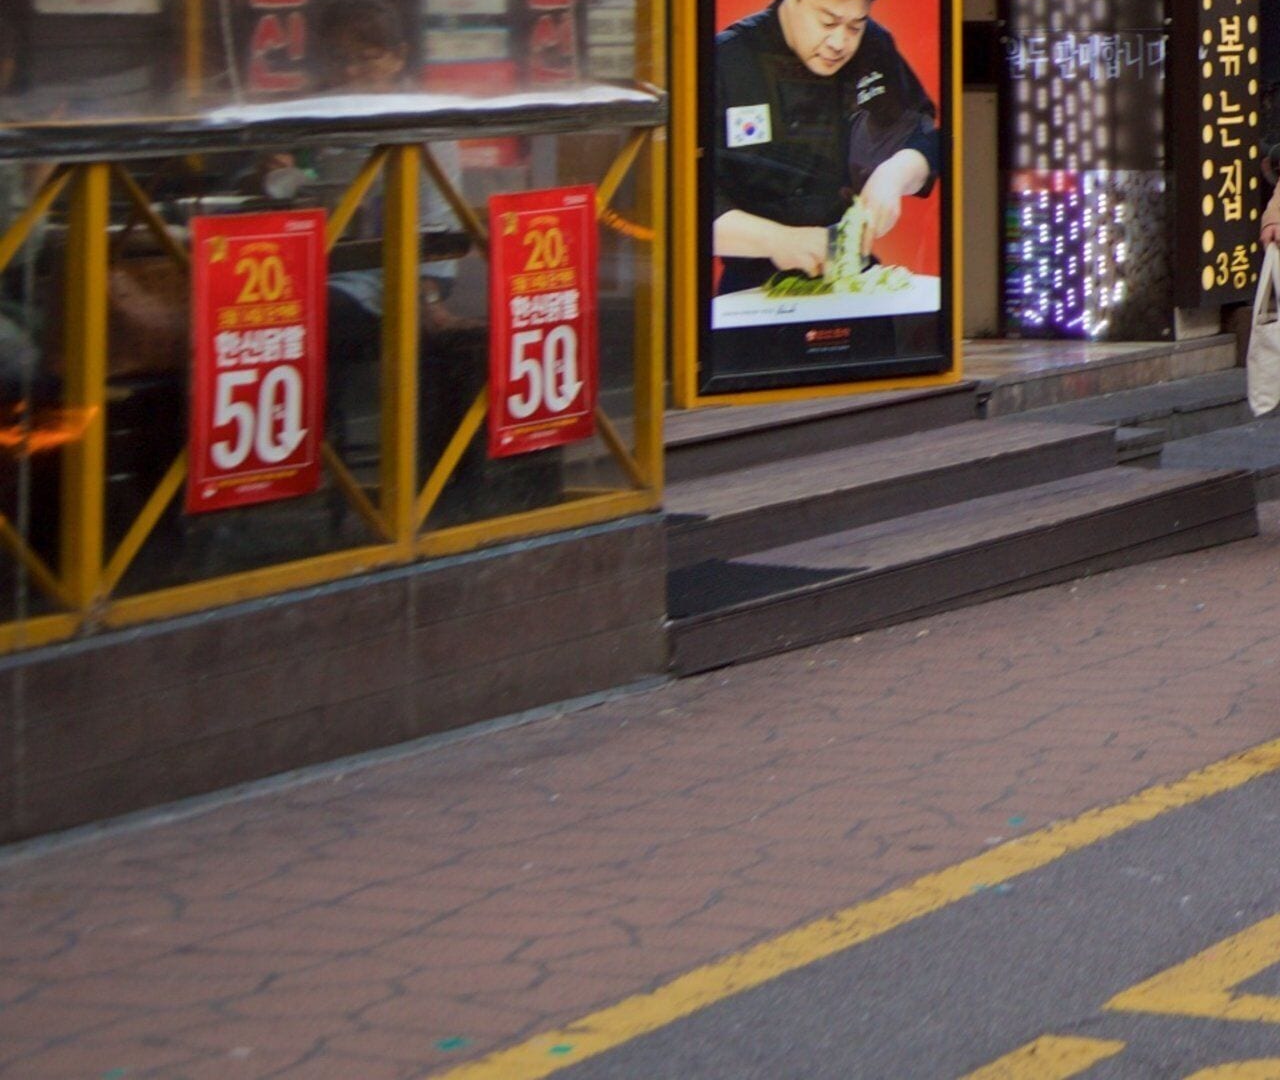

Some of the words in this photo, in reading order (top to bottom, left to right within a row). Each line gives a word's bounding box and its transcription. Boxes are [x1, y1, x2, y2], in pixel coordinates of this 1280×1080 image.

[1006, 34, 1049, 81] 원두
[522, 227, 564, 271] 20
[1216, 245, 1251, 290] 3층
[233, 255, 285, 305] 20
[507, 323, 585, 420] 50
[209, 364, 309, 471] 50
